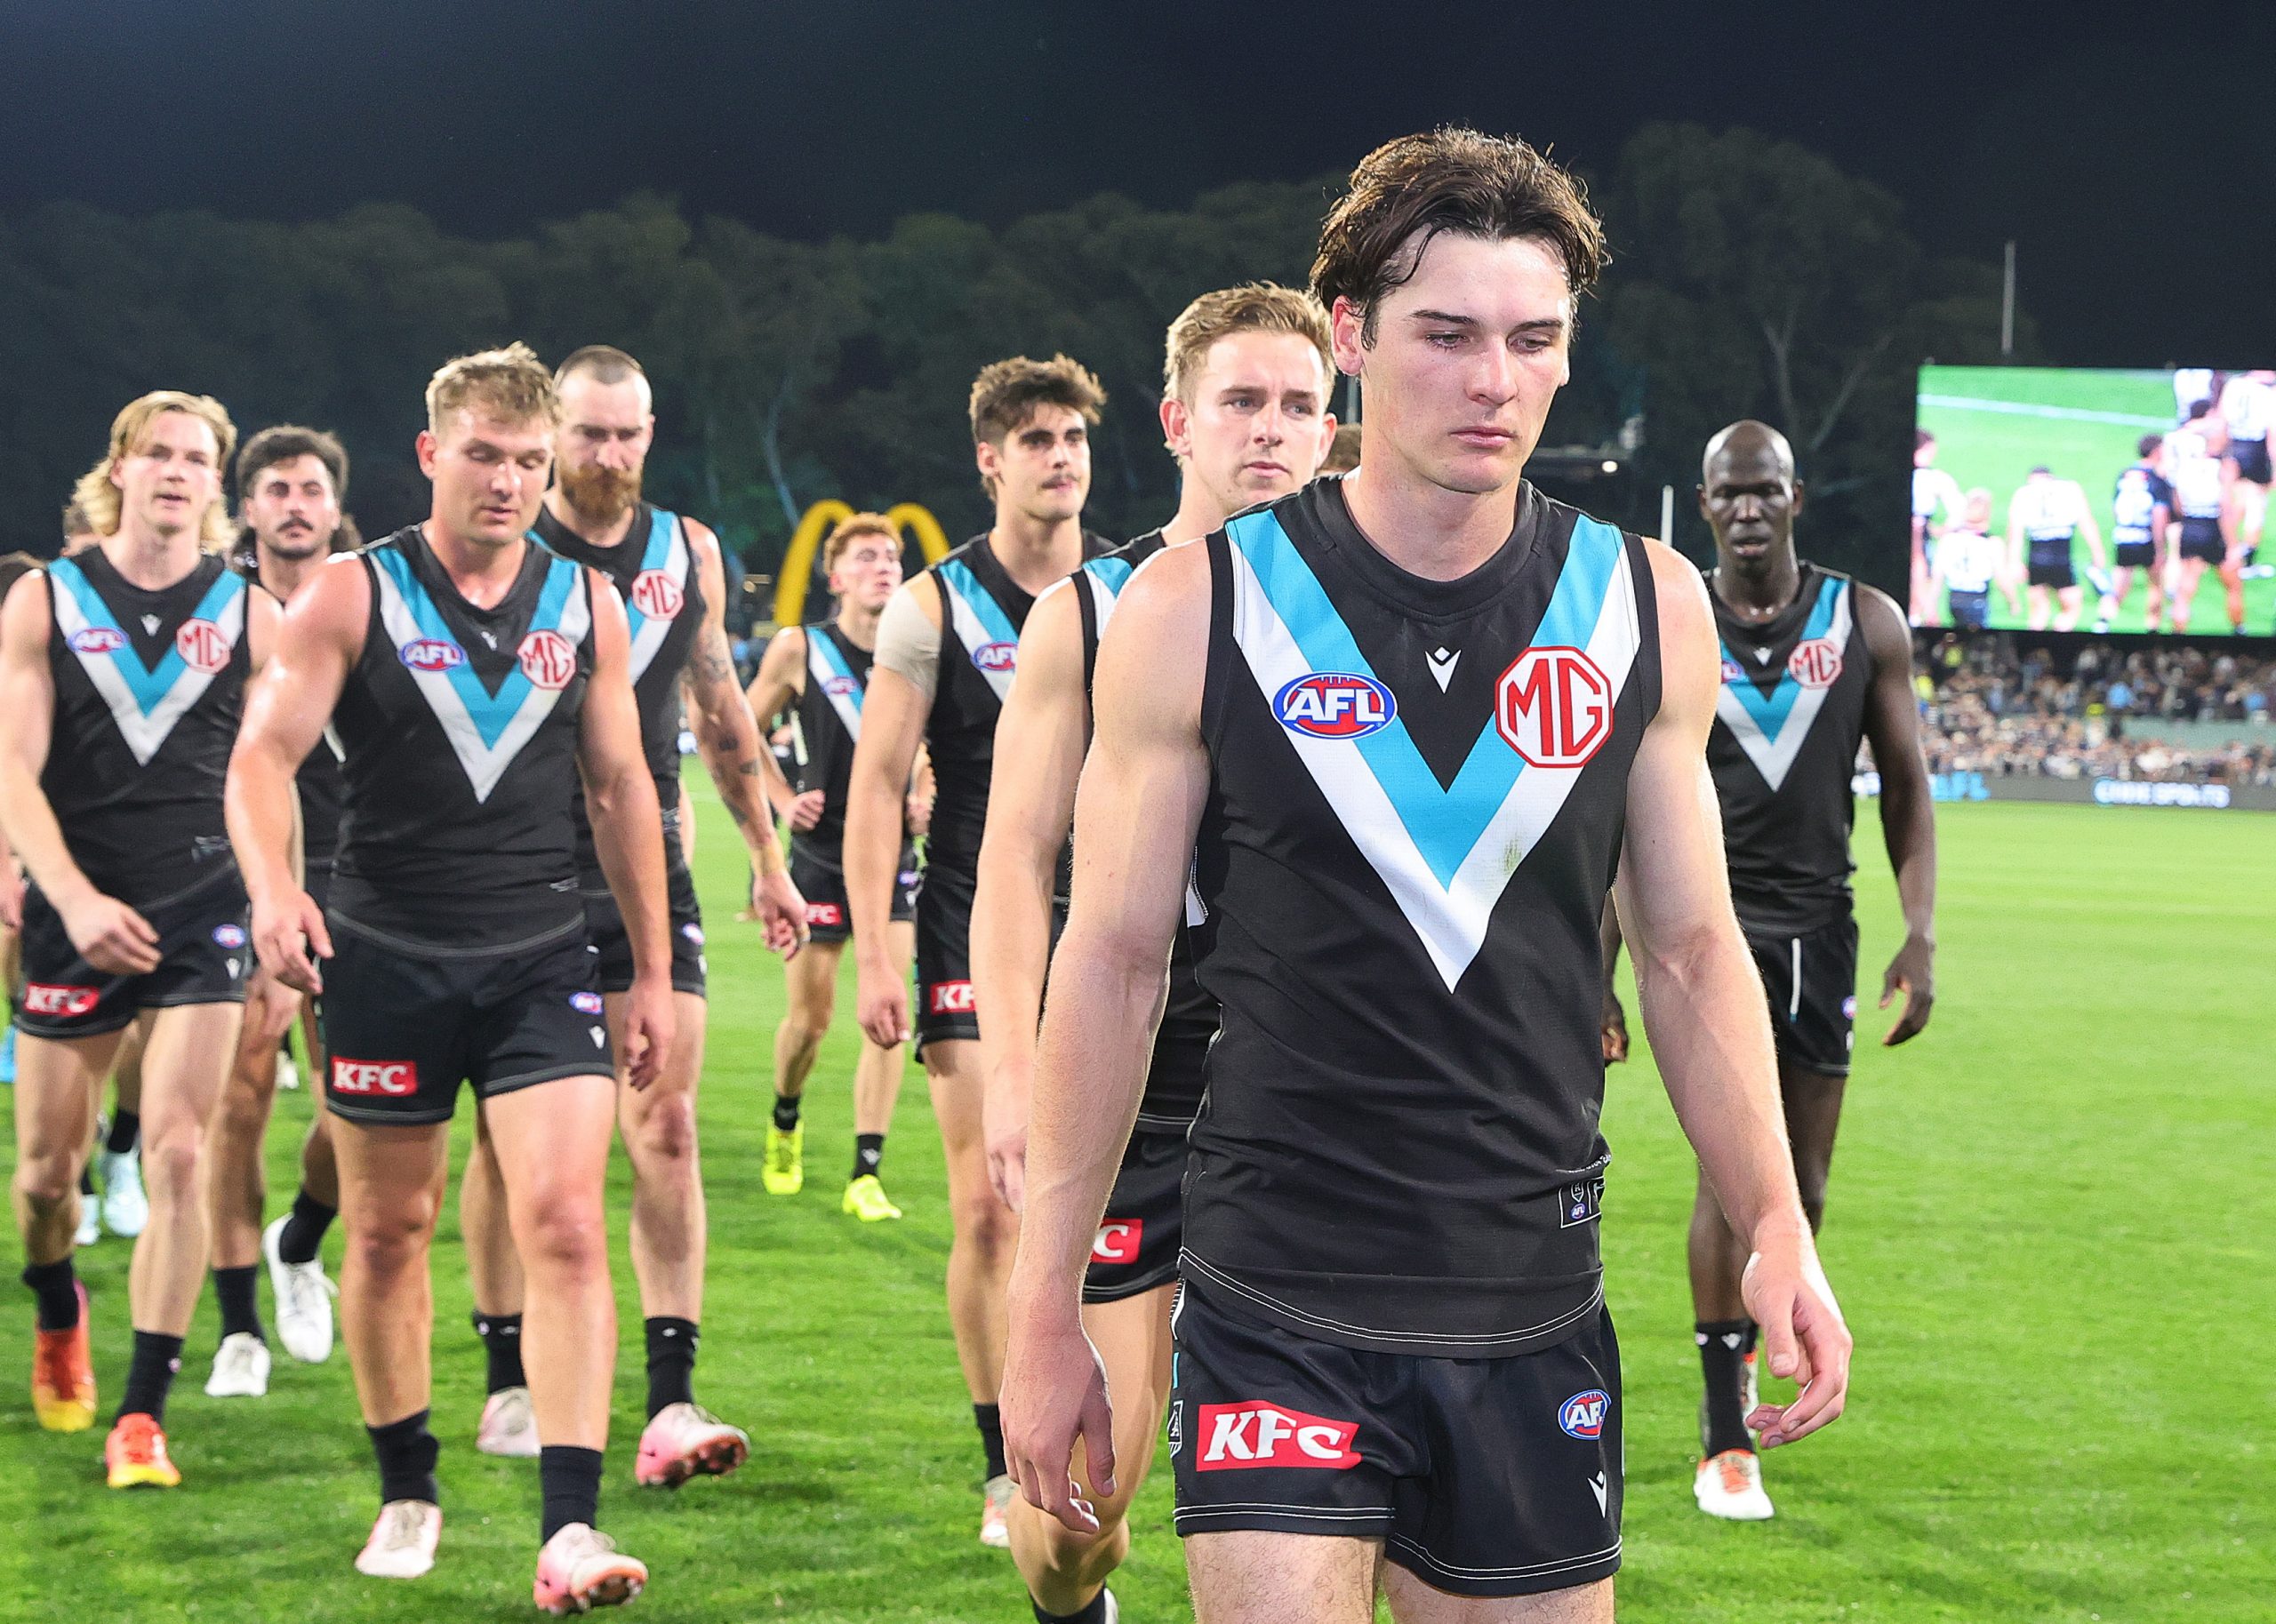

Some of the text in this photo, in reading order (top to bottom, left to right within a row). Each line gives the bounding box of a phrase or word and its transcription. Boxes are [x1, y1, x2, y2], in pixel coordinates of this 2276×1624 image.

[639, 575, 679, 615] MG
[182, 626, 224, 667] MG
[405, 644, 461, 666] AFL
[523, 635, 574, 684] MG
[1794, 645, 1837, 684] MG
[1283, 687, 1386, 722] AFL
[1507, 658, 1602, 757] MG
[806, 903, 838, 924] FC
[27, 985, 92, 1013] KFC
[934, 983, 975, 1011] KF
[333, 1061, 407, 1093] KFC
[1567, 1400, 1603, 1430] AF
[1203, 1409, 1343, 1462] KFC
